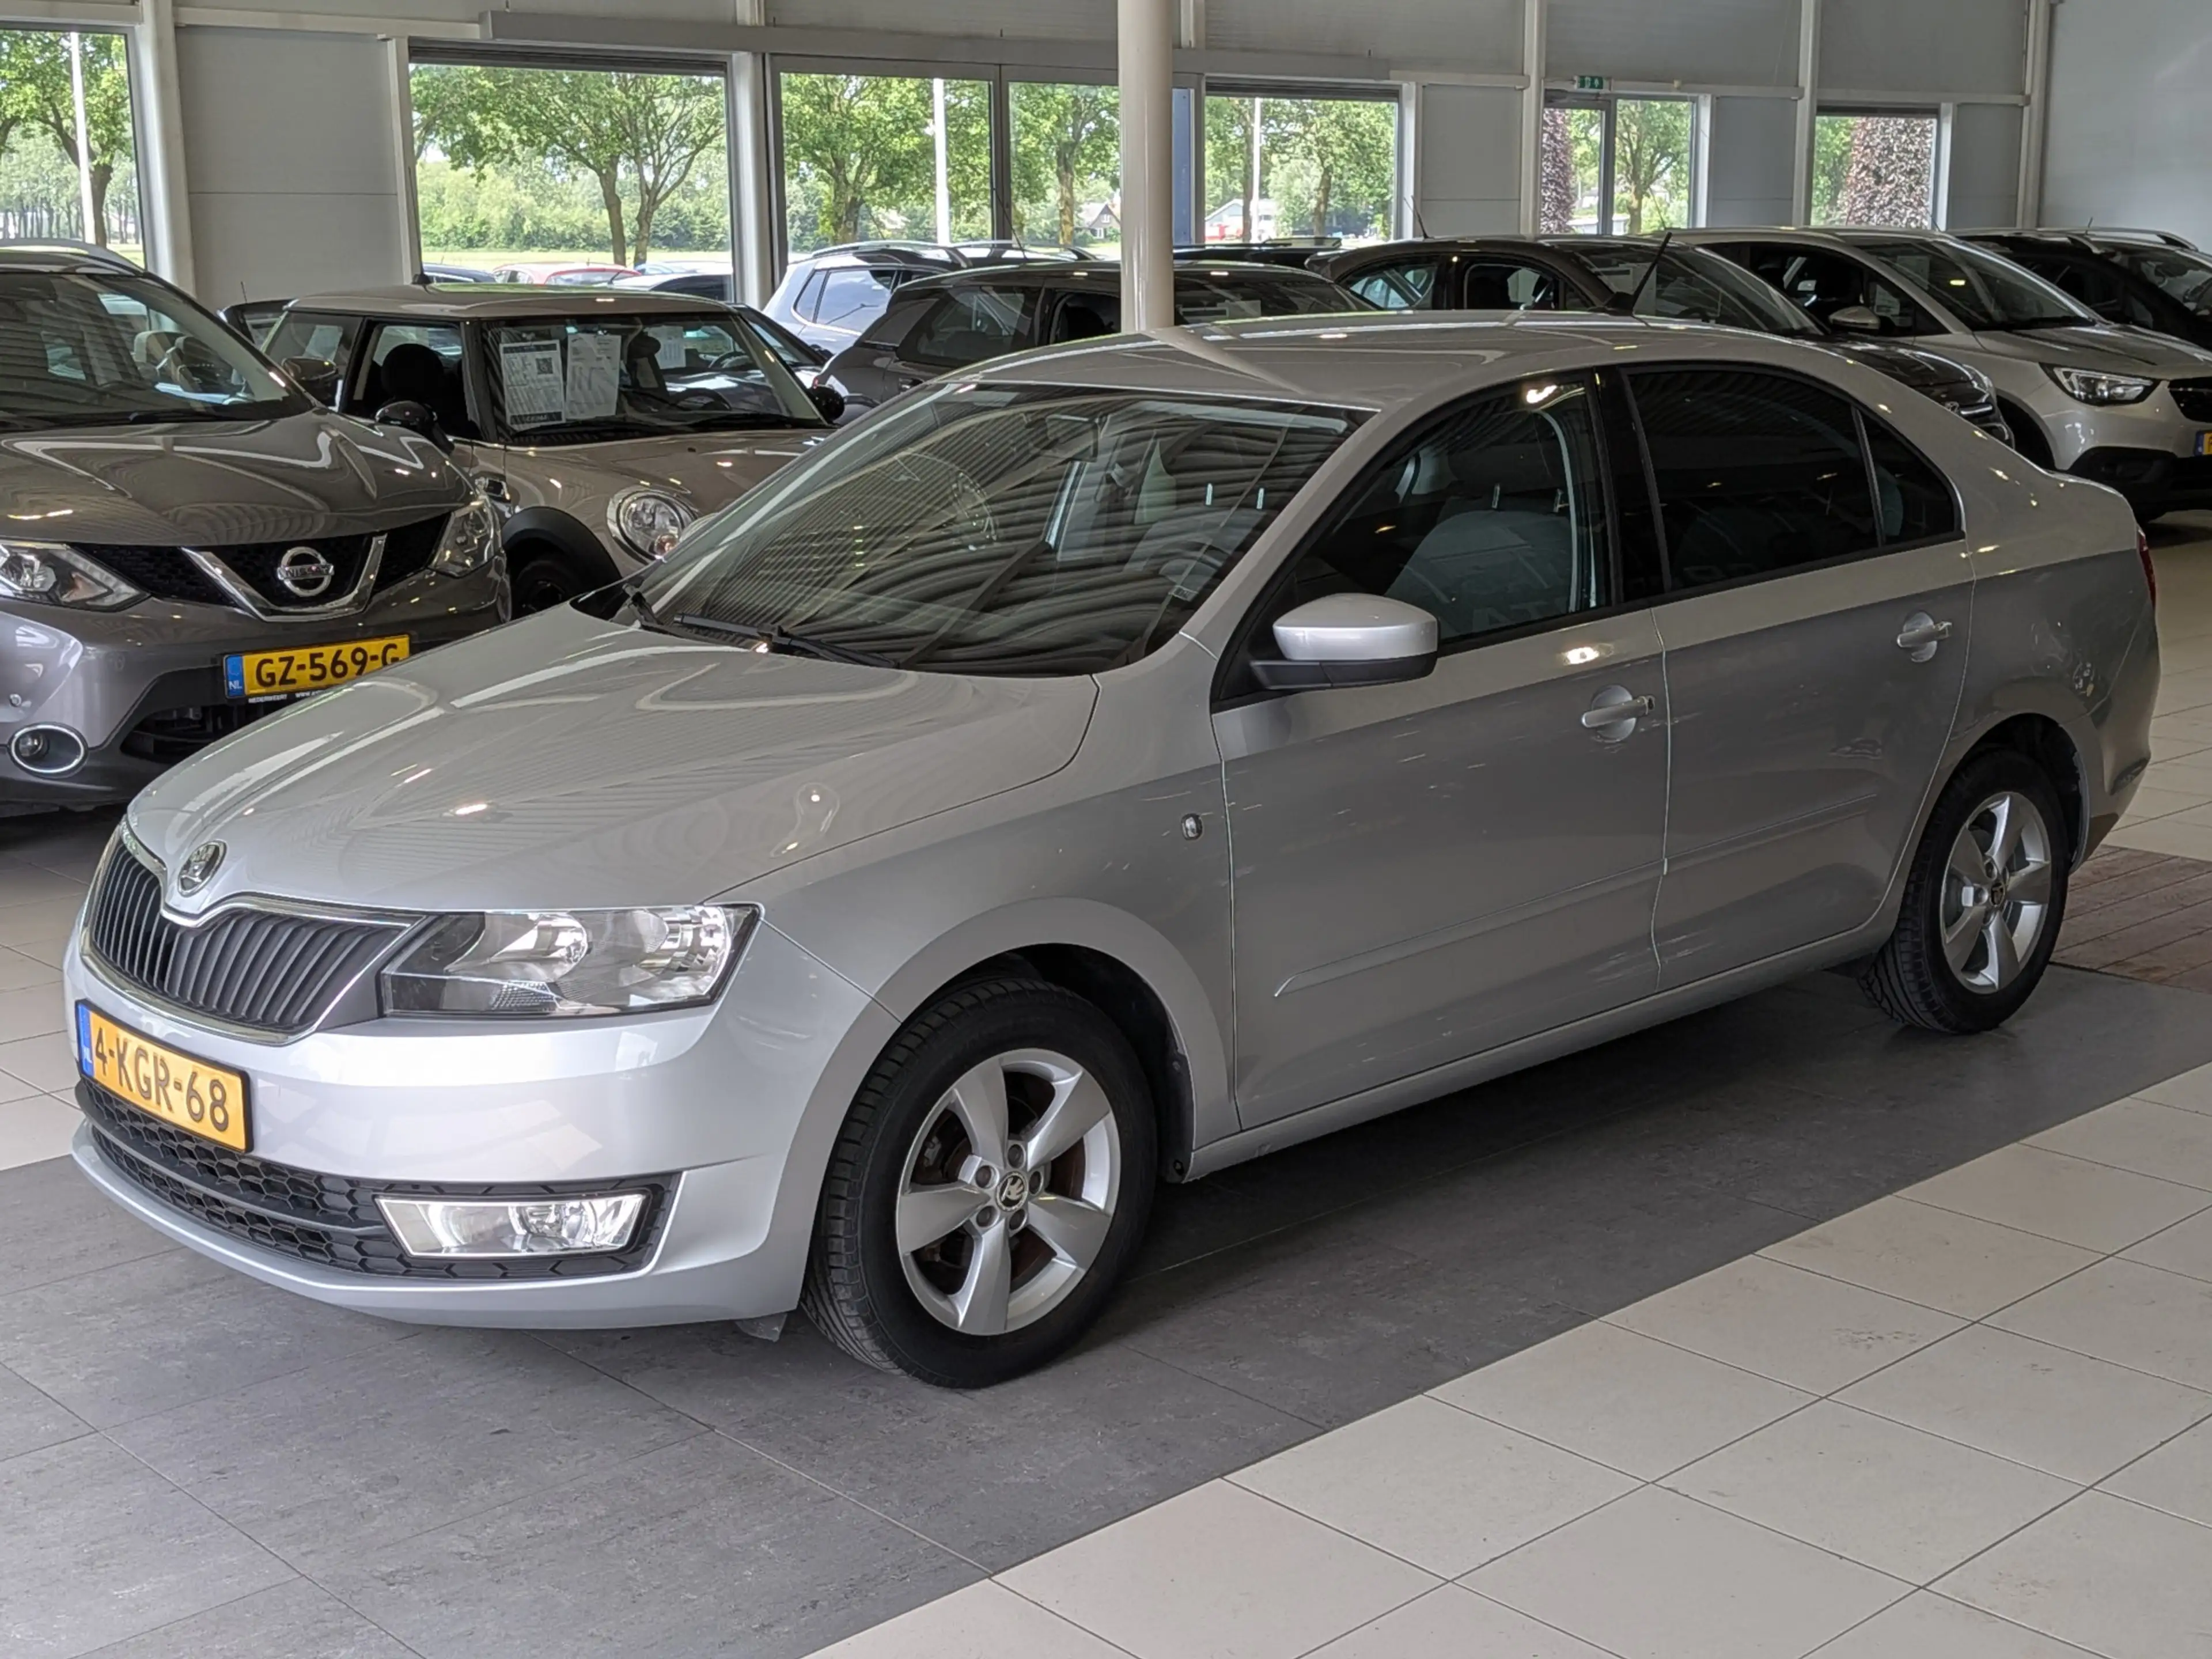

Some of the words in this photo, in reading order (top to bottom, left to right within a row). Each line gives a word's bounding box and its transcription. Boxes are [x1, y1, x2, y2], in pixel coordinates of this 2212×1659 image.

[229, 680, 243, 690] NL
[256, 643, 399, 688] GZ-569-G
[95, 1027, 229, 1132] 4-KGR-68
